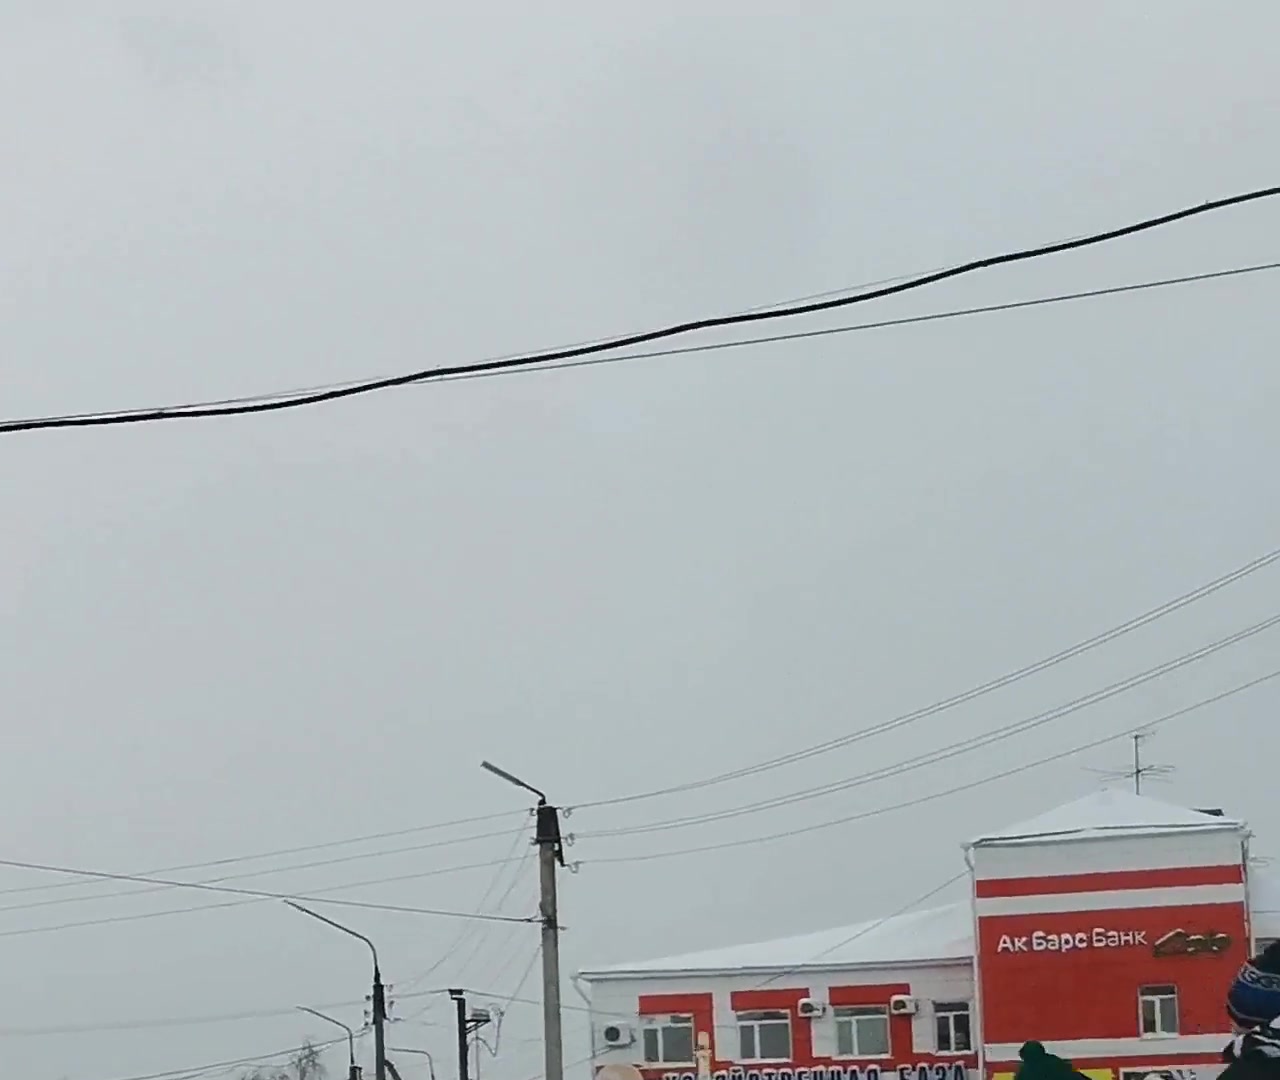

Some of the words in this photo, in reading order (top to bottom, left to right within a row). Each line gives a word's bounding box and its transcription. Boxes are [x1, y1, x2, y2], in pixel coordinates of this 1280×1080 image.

[997, 934, 1028, 953] Ак
[1032, 930, 1088, 953] Барс
[1092, 927, 1148, 948] Банк
